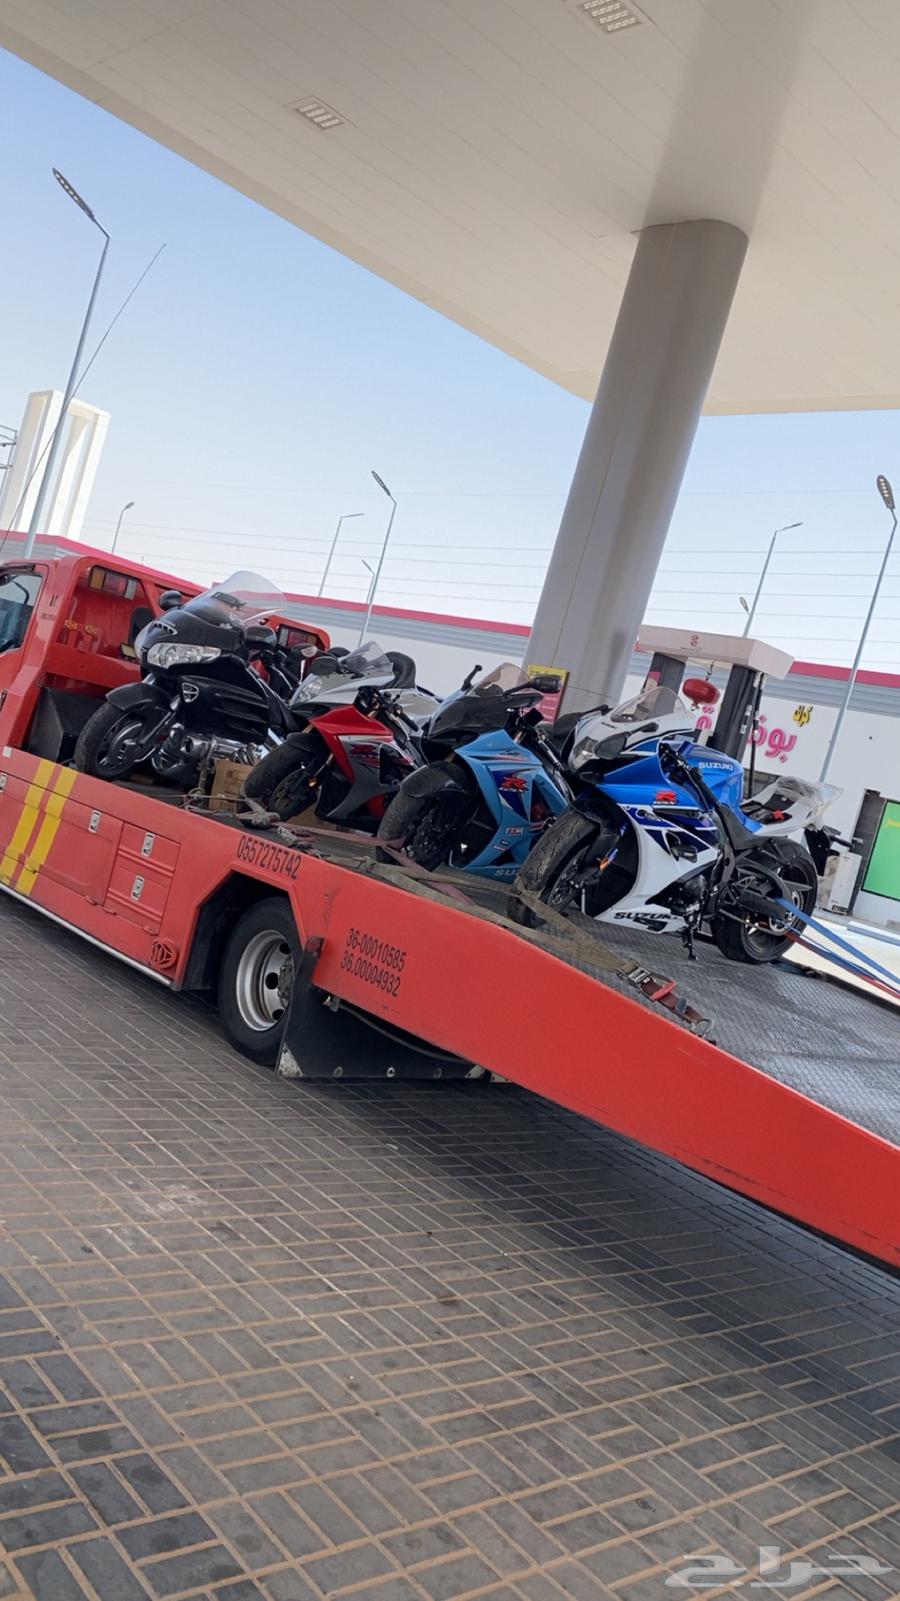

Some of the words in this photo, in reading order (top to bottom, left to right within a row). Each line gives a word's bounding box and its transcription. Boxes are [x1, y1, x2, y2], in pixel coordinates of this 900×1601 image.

[698, 762, 734, 771] SUZUKI
[237, 835, 303, 880] 0557275742
[346, 927, 407, 973] 36-00010585
[340, 950, 401, 998] 36.00004932
